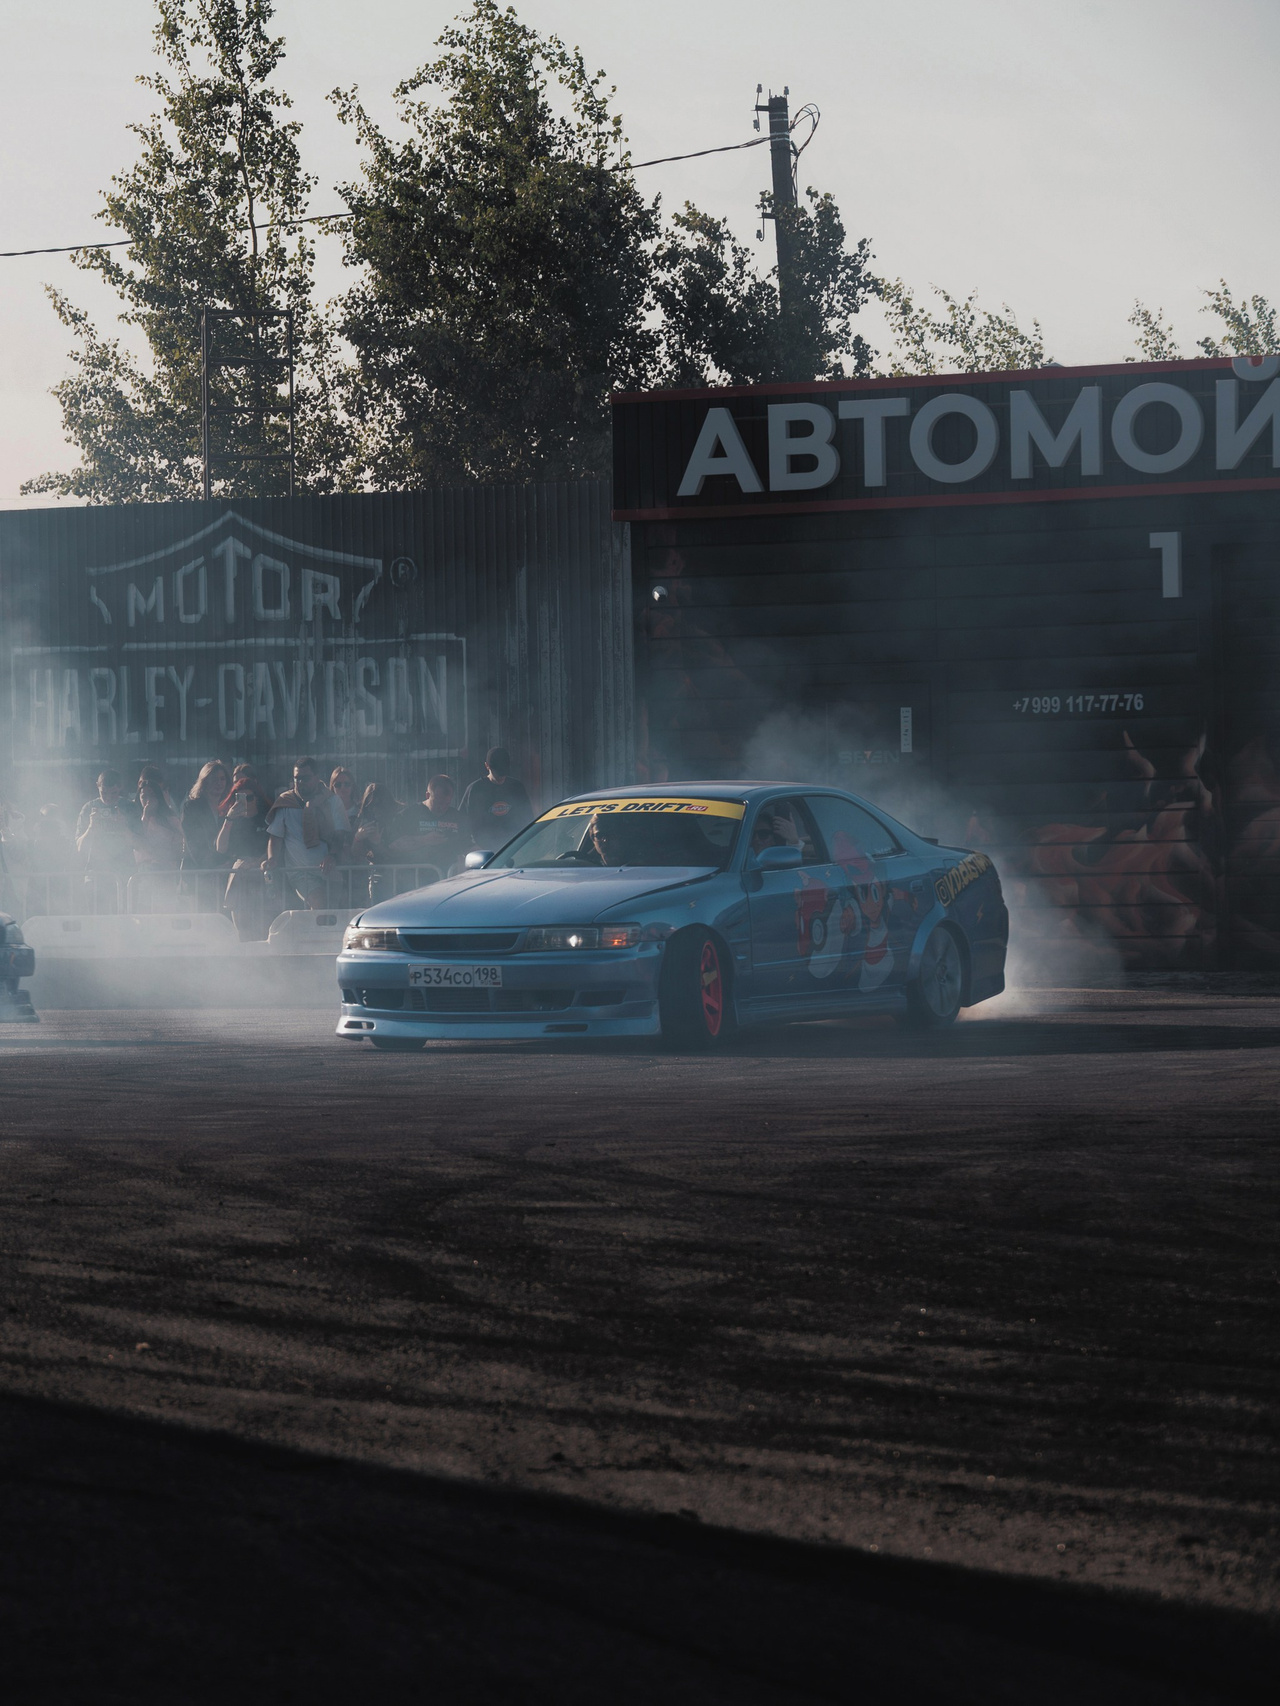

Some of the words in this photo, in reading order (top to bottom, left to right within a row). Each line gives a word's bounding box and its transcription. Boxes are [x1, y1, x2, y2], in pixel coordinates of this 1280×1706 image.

[127, 536, 342, 627] MOTOR
[1149, 531, 1183, 599] 1
[30, 654, 448, 749] HARLEY-DAVIDSON
[1031, 696, 1062, 715] 999
[1065, 692, 1145, 713] 117-77-76
[557, 803, 620, 817] LET'S
[475, 967, 498, 981] 198
